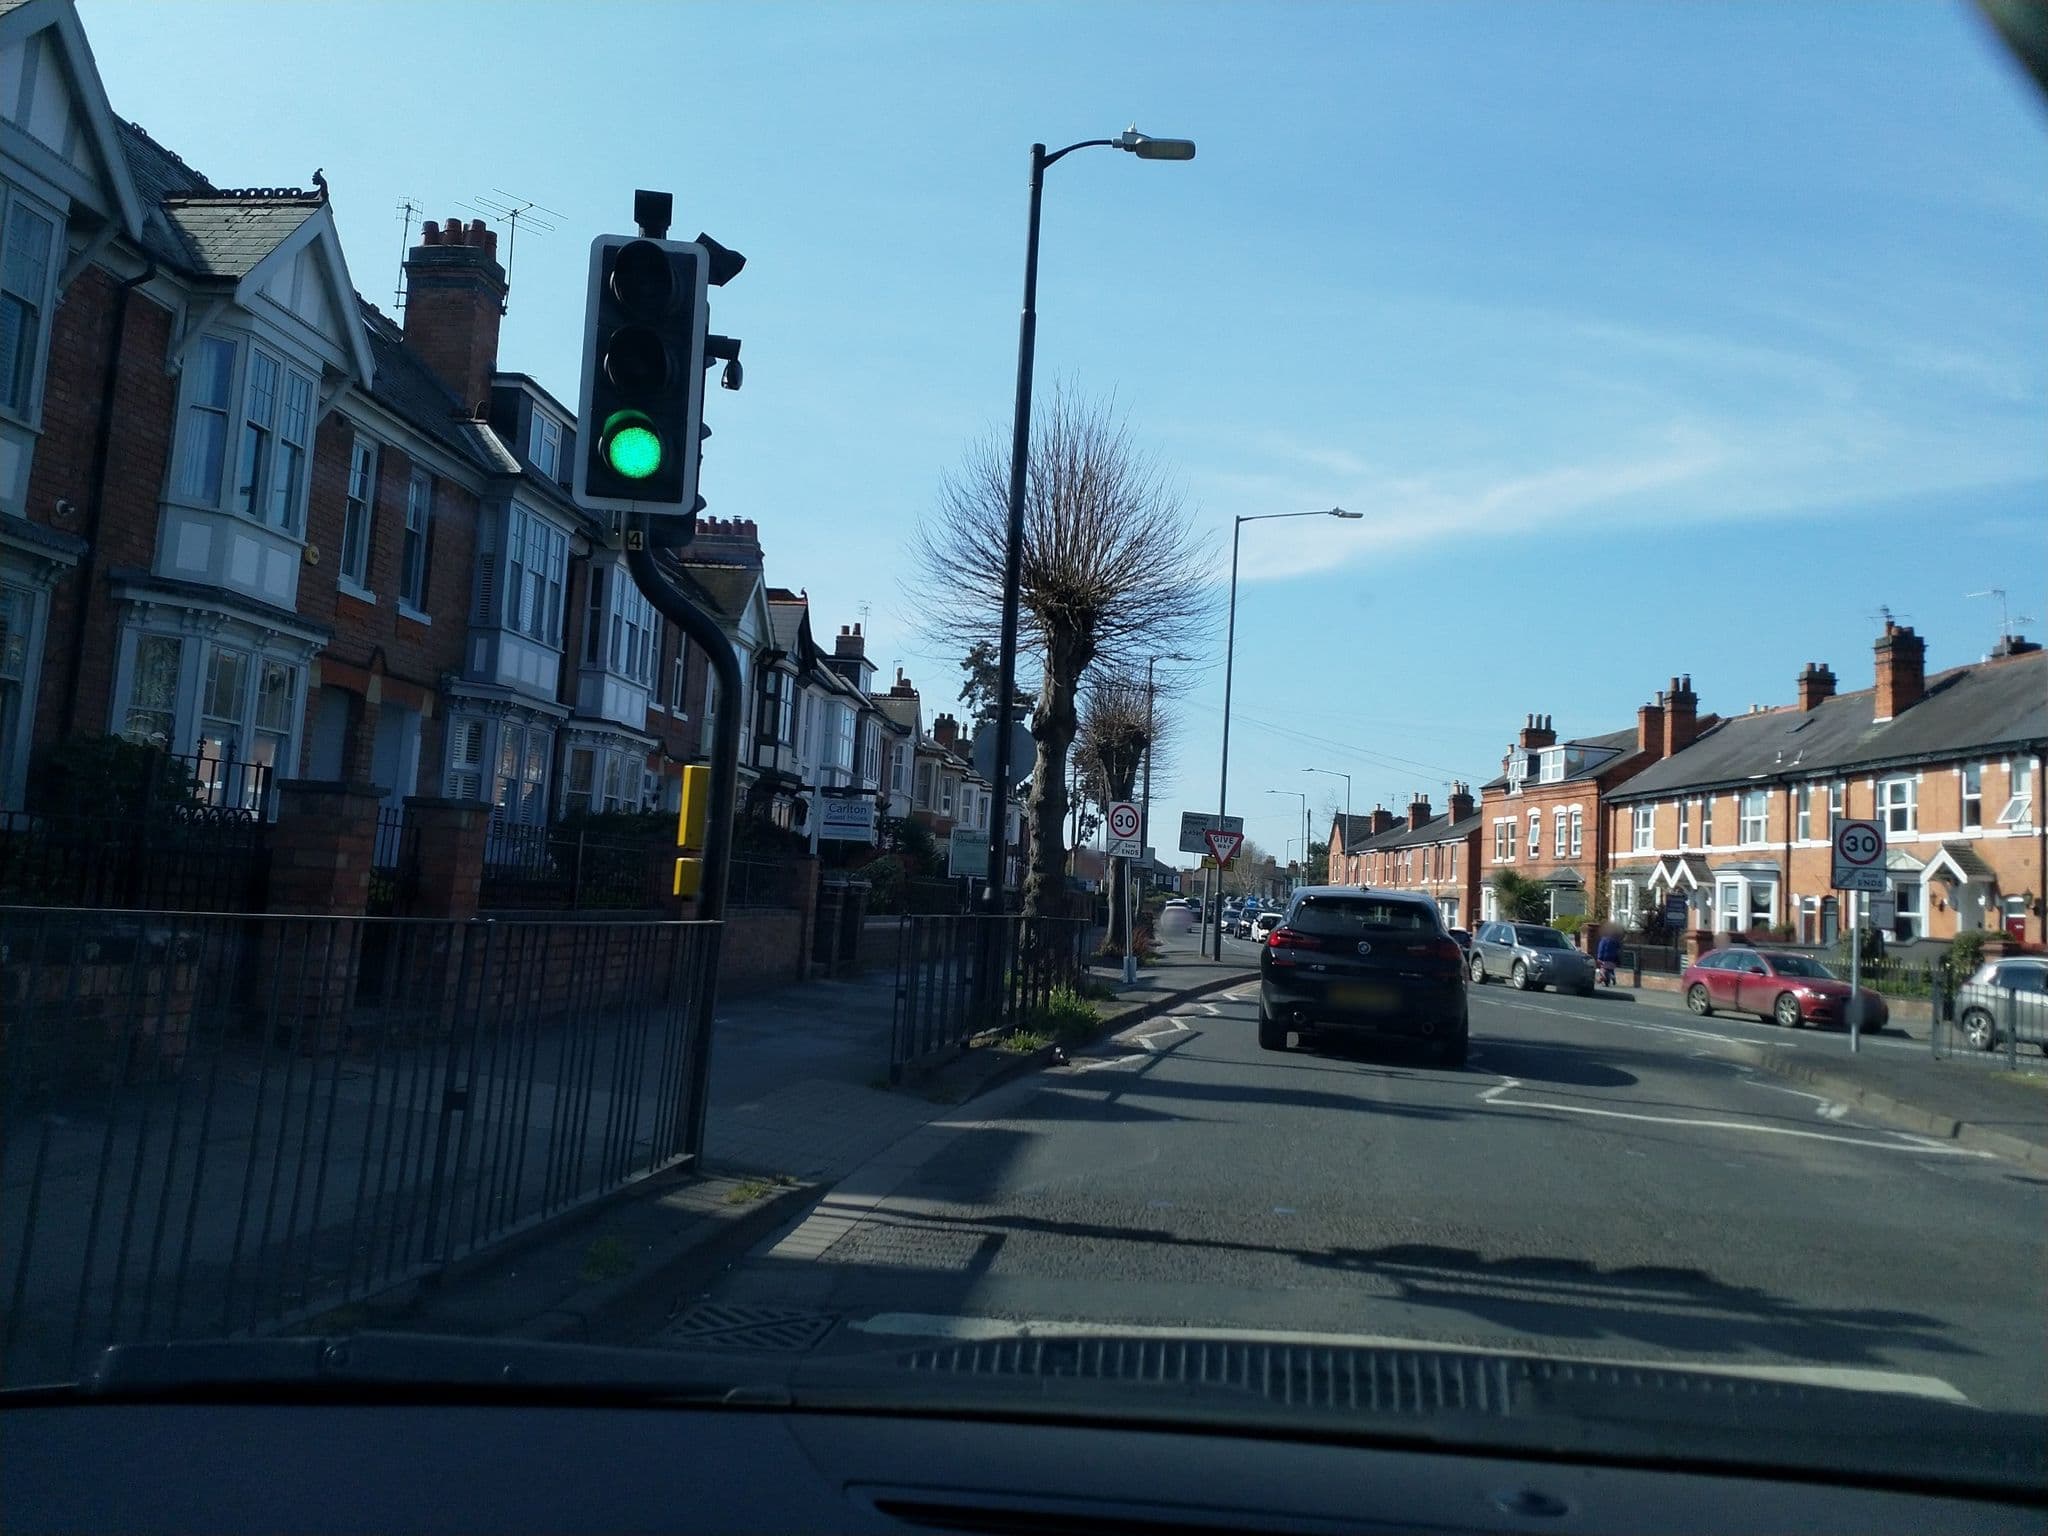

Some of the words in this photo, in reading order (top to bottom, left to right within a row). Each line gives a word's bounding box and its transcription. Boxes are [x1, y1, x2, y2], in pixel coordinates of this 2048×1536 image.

[629, 532, 641, 549] 4
[829, 803, 867, 814] Carlton
[1115, 814, 1135, 828] 30
[1213, 835, 1234, 845] GIVE
[1845, 835, 1876, 853] 30
[1121, 848, 1139, 856] ENDS
[1857, 879, 1883, 887] ENDS
